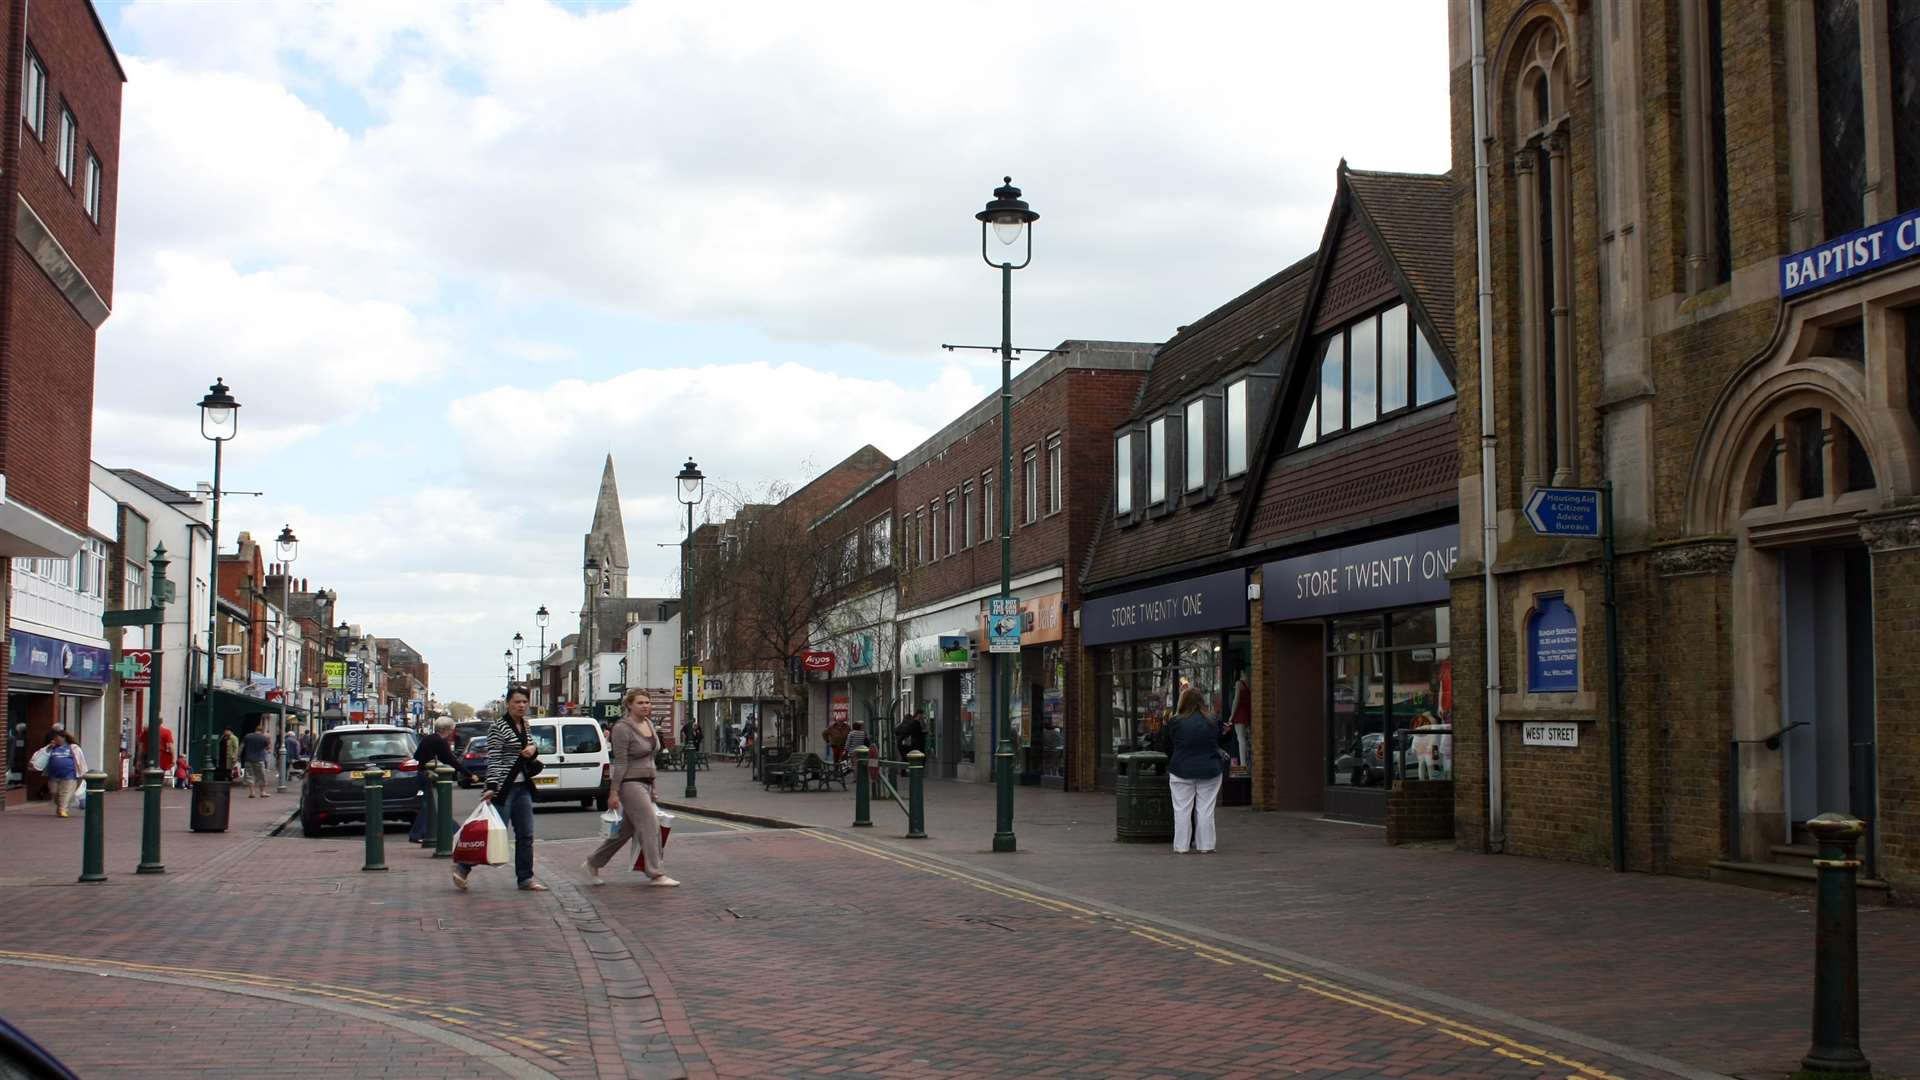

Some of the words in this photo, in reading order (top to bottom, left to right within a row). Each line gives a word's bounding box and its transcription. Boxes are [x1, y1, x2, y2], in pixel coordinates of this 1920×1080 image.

[1785, 231, 1883, 290] BAPTIST
[1547, 495, 1580, 505] Housing
[1582, 496, 1595, 505] Aid
[1558, 503, 1591, 513] Citizens
[1557, 513, 1585, 522] Advice
[1296, 568, 1338, 600] STORE
[1344, 553, 1414, 592] TWENTY
[1112, 604, 1136, 628] STORE
[1139, 597, 1179, 623] TWENTY
[1182, 593, 1203, 617] ONE
[805, 656, 831, 665] Argos
[1525, 726, 1545, 741] WEST
[1548, 727, 1575, 742] STREET
